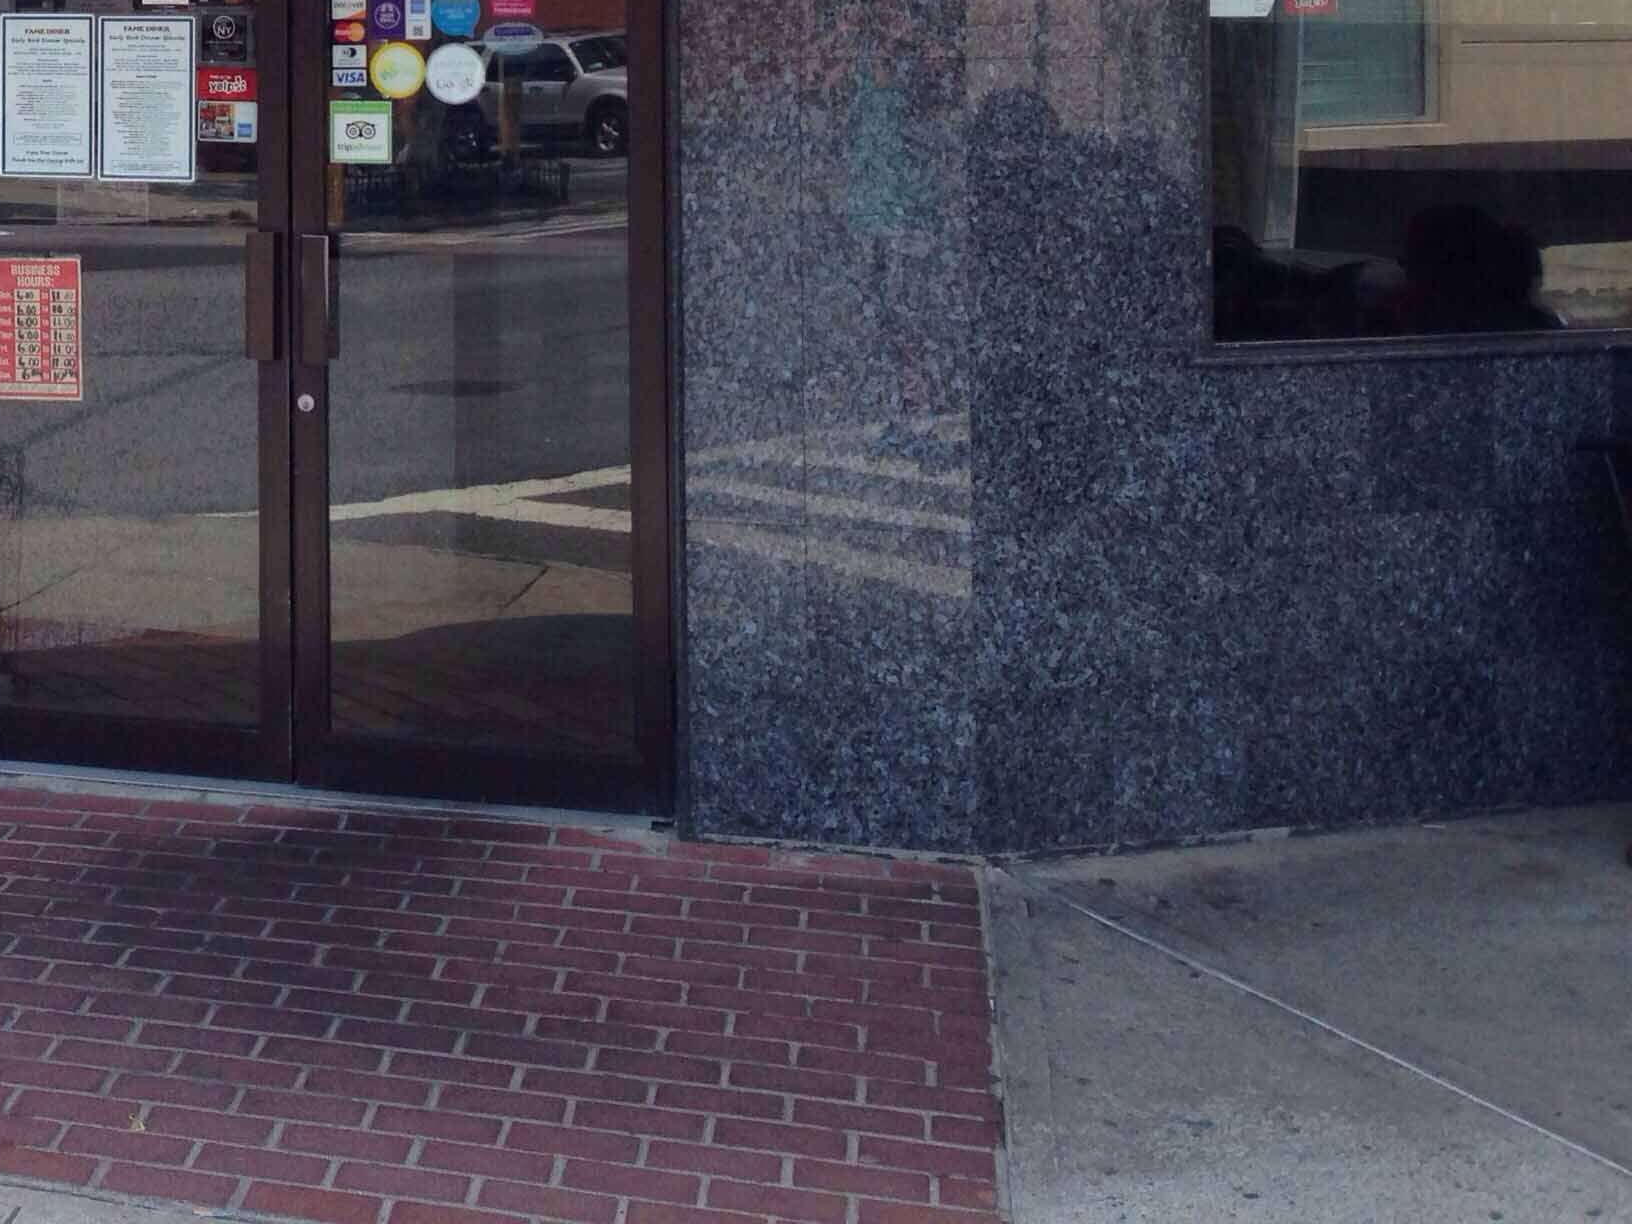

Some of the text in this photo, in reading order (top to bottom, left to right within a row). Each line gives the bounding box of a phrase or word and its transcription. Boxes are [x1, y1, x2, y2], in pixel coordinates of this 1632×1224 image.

[336, 72, 365, 83] VISA
[11, 264, 60, 276] BUSINESS
[17, 277, 54, 288] HOURS:
